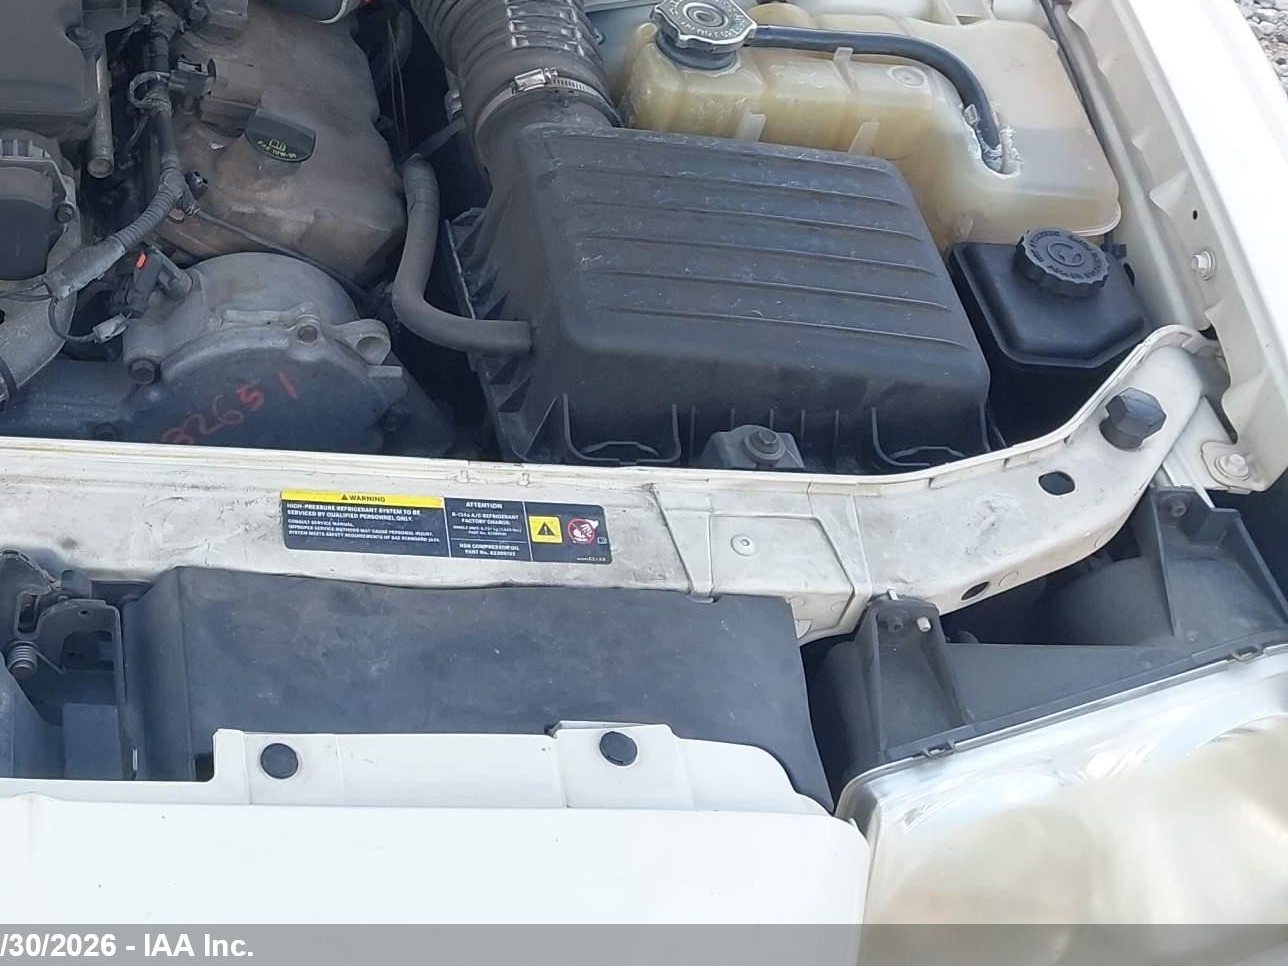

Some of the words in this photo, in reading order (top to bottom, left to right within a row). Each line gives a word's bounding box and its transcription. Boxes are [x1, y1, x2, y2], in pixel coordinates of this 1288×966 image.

[349, 495, 386, 503] WARNING
[286, 503, 336, 511] HIGH-PRESSURE
[336, 505, 378, 513] REFRIGERANT
[465, 501, 503, 509] ATTENTION
[287, 509, 317, 517] SERVICED
[359, 513, 395, 521] PERSONNEL
